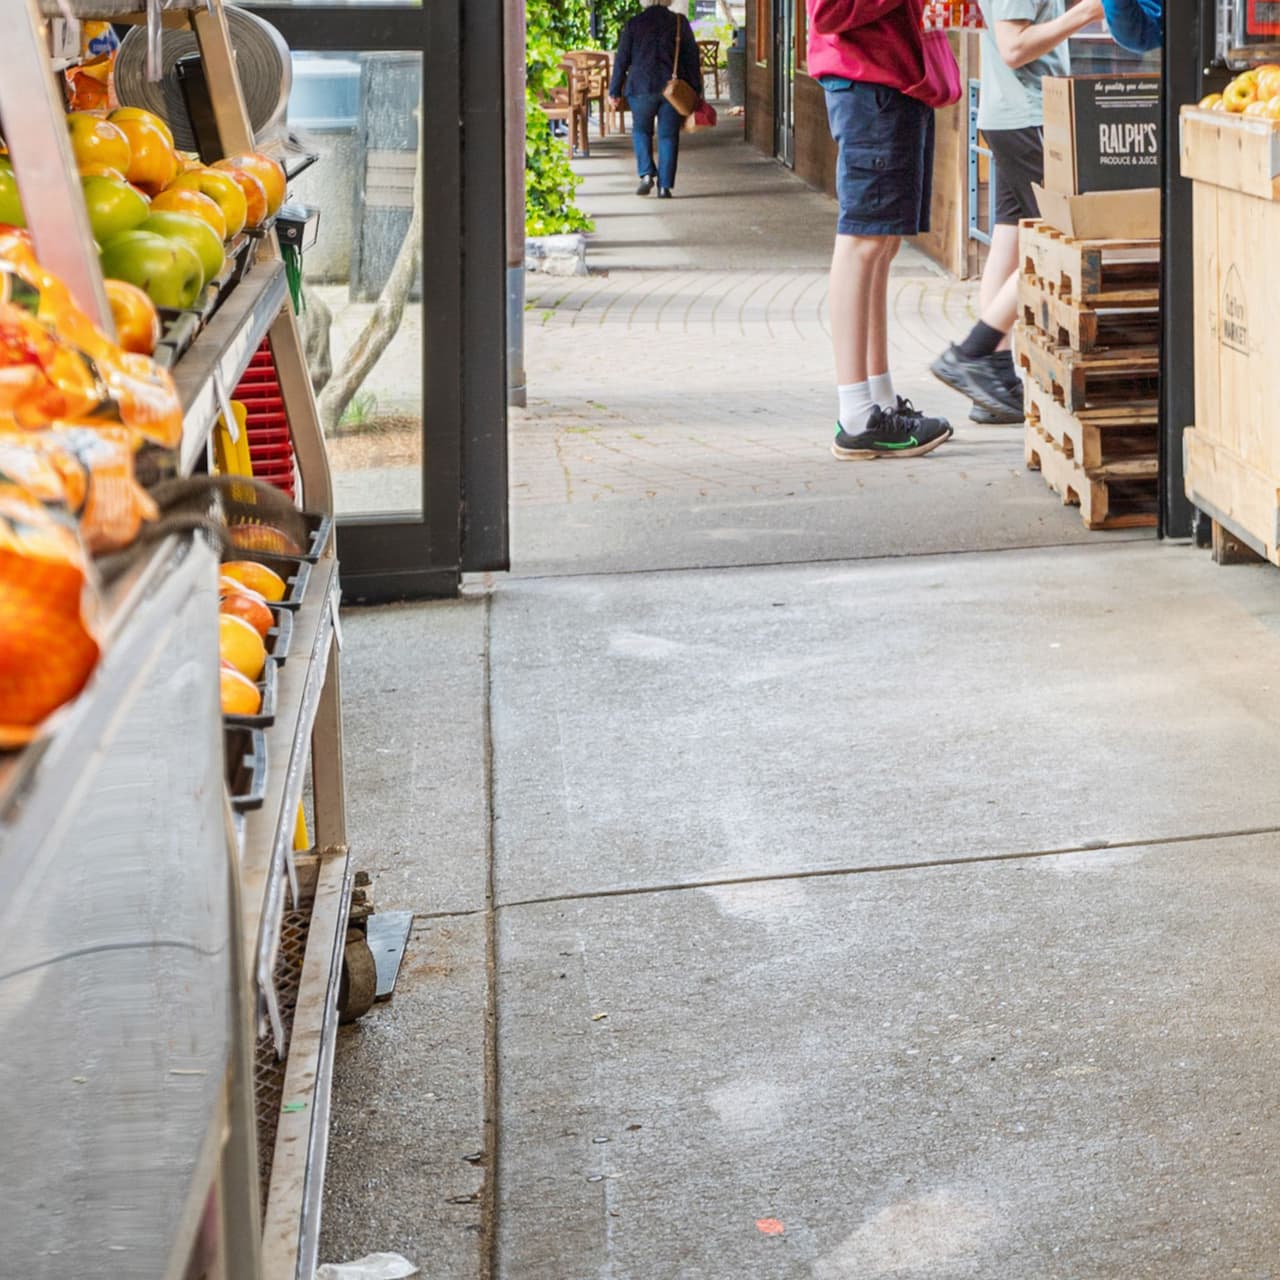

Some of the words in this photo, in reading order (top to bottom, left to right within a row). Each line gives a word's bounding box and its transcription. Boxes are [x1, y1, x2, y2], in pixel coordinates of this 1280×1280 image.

[1099, 122, 1158, 154] RALPH'S
[1099, 155, 1131, 166] PRODUCE
[1131, 155, 1138, 165] &
[1138, 155, 1158, 166] JUICE
